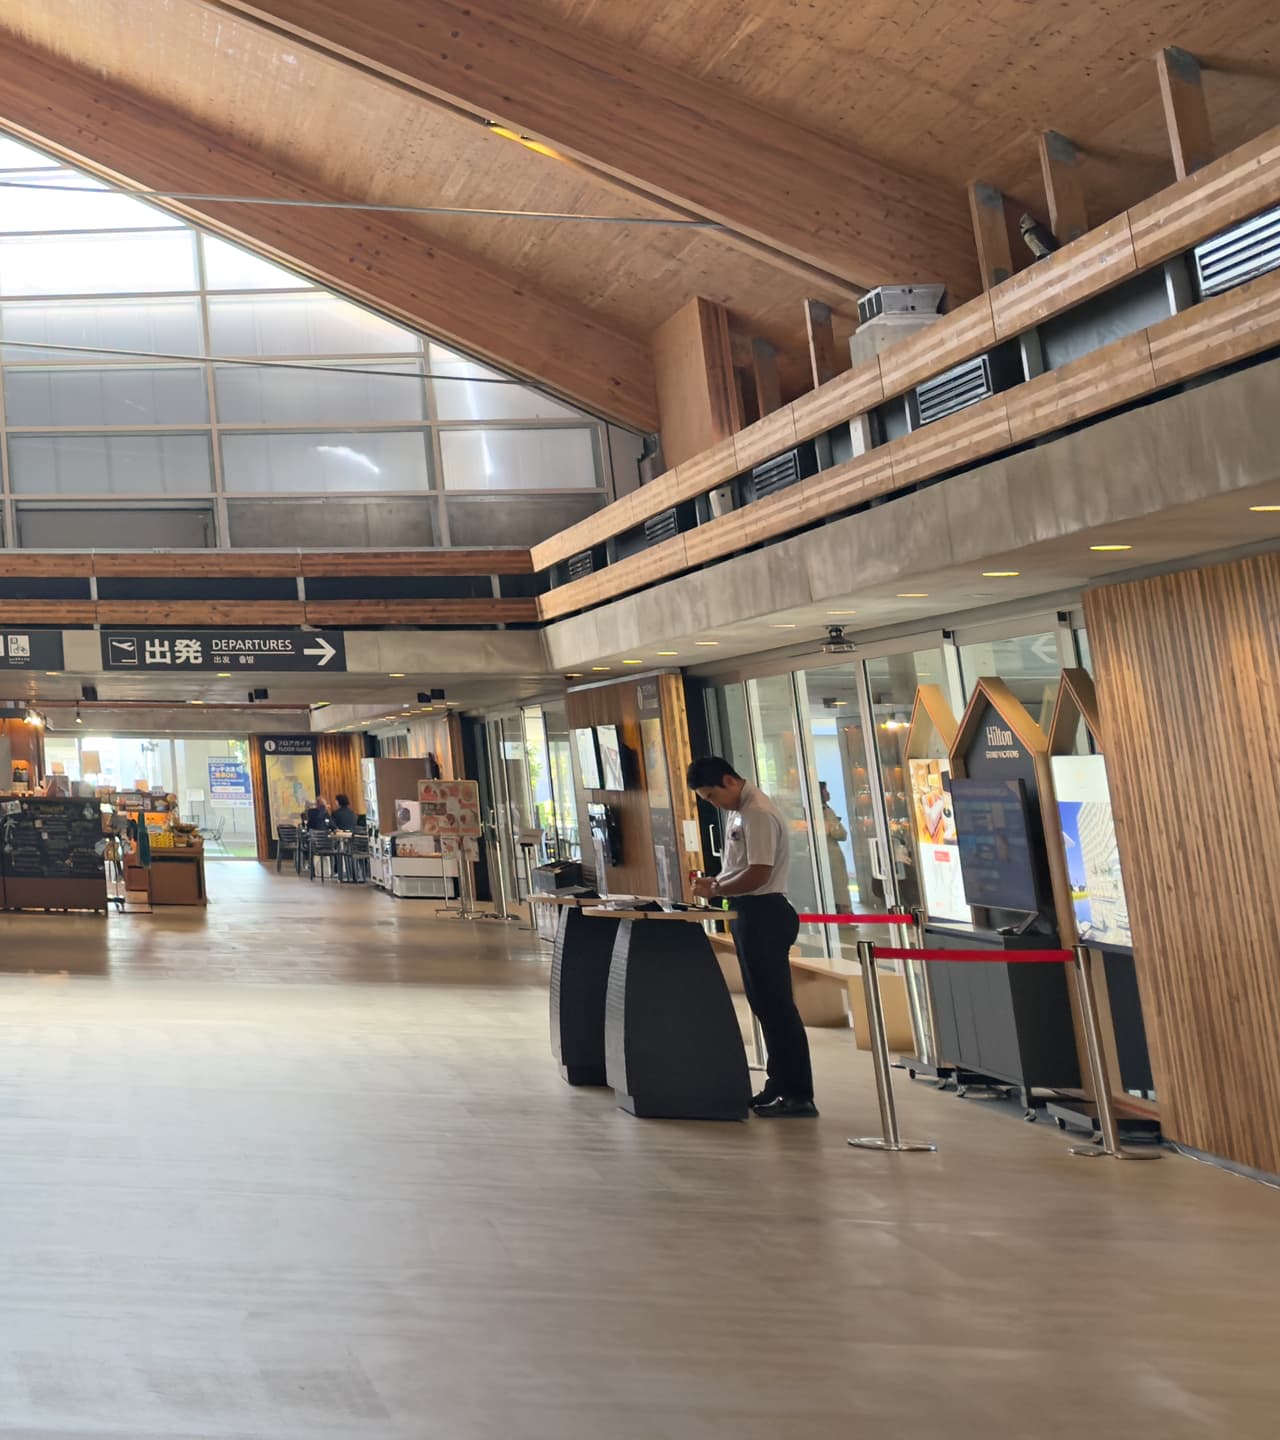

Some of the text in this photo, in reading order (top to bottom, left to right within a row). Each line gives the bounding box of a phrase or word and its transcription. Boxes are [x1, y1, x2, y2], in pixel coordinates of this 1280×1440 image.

[144, 638, 203, 664] 出発
[212, 639, 292, 651] DEPARTURES
[986, 726, 1013, 746] Hilton
